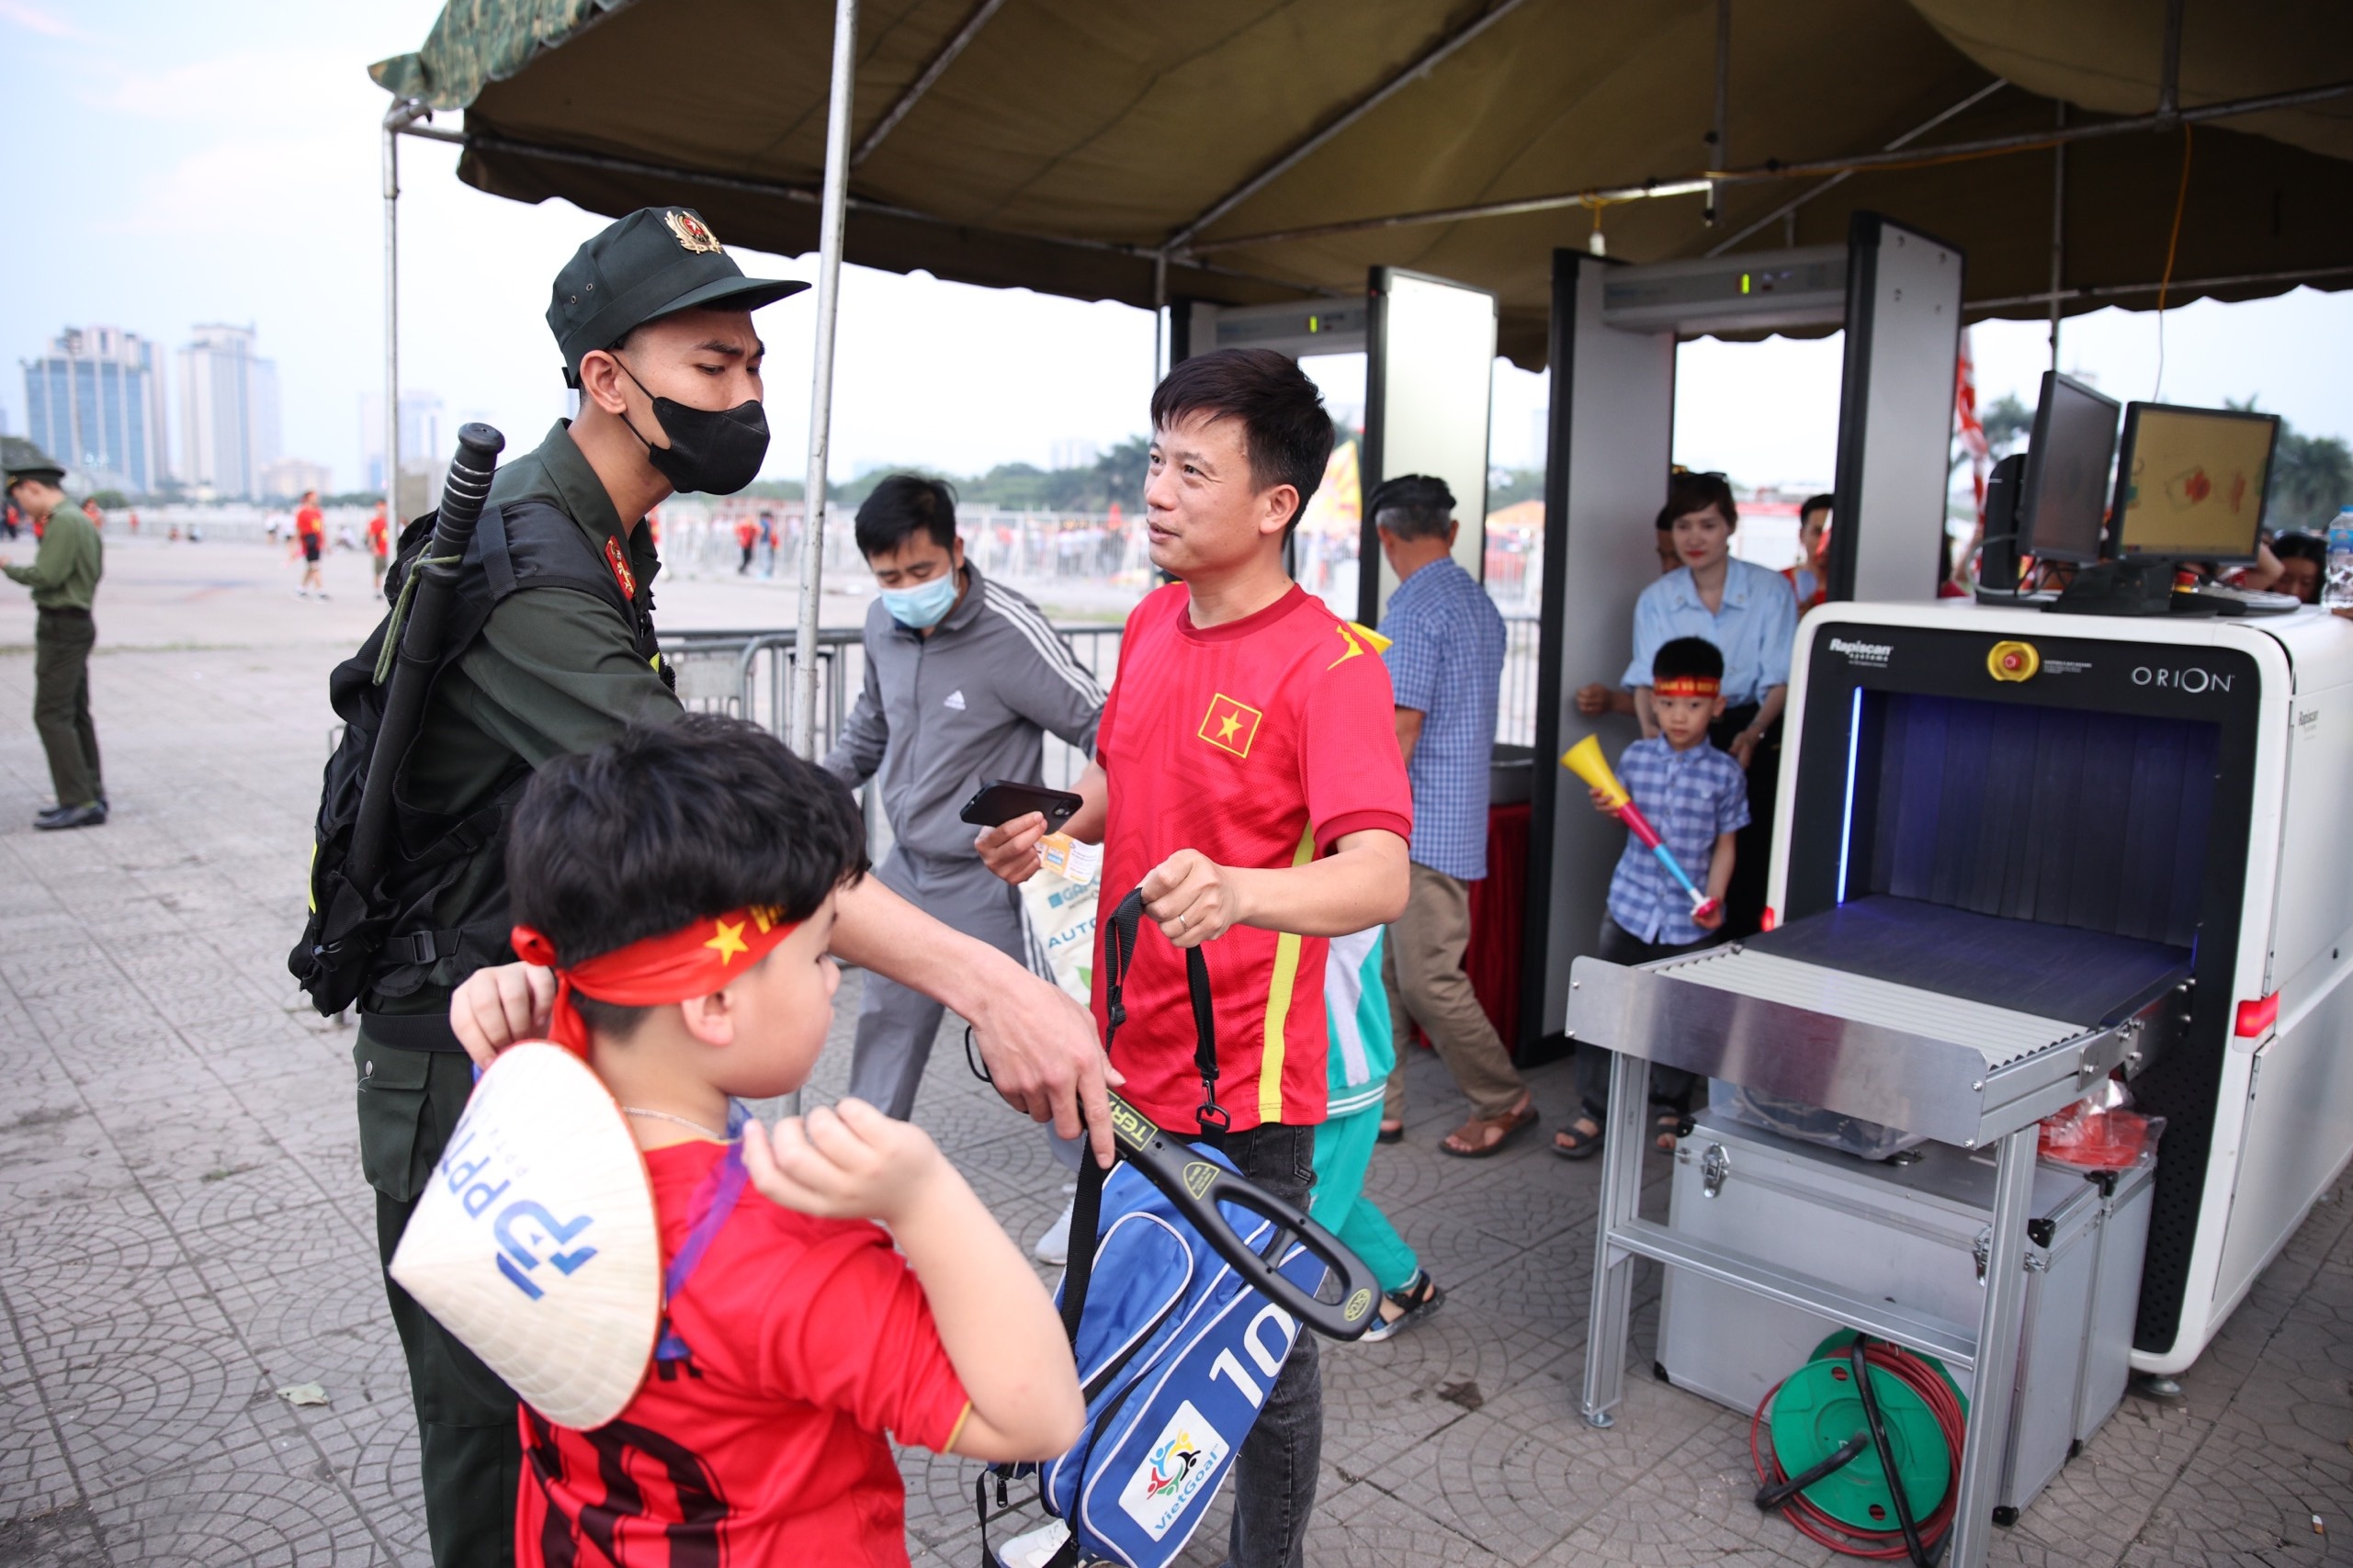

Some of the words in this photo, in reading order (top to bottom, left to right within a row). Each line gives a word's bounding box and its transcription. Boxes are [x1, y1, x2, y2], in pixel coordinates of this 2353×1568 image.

[2132, 666, 2232, 693] ORION
[1109, 1101, 1148, 1143] TER
[1208, 1302, 1296, 1410] 10
[1154, 1450, 1218, 1530] VietGoal
